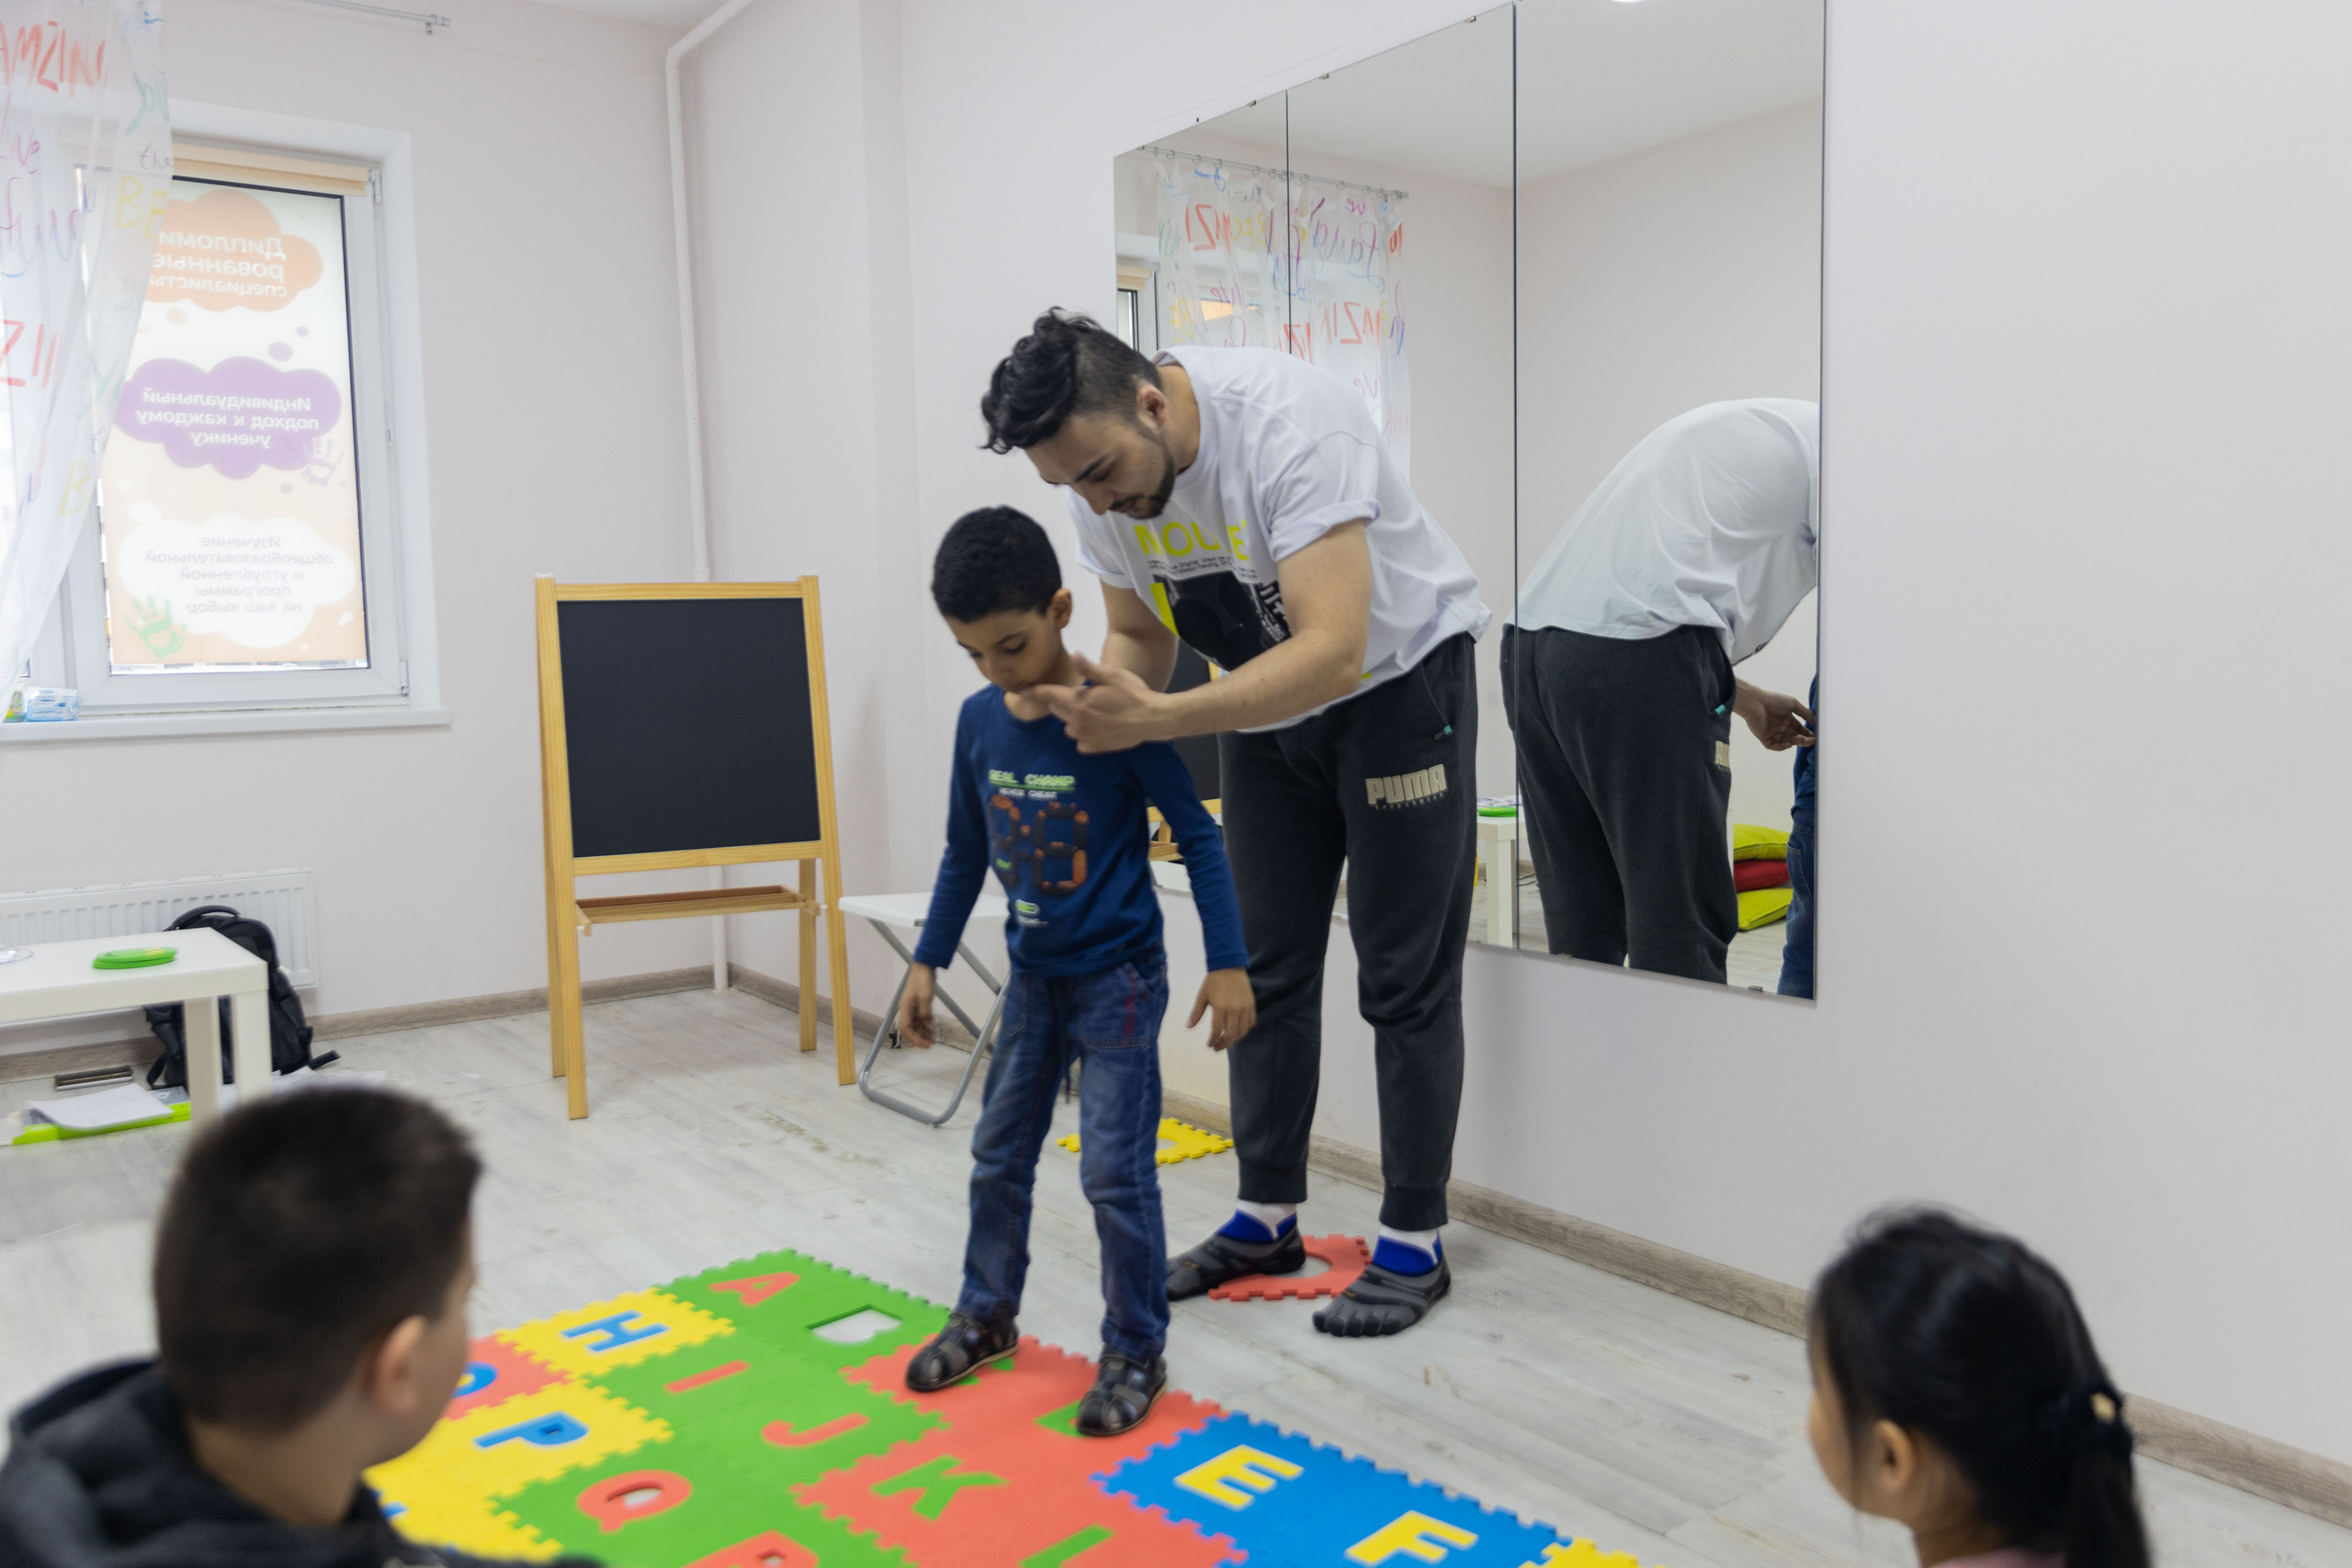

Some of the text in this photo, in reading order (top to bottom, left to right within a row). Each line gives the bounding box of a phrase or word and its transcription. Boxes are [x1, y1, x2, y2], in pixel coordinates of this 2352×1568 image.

[1364, 763, 1448, 805] PUMA
[708, 1270, 801, 1307] A
[560, 1309, 673, 1354] H
[662, 1359, 752, 1394] I
[471, 1409, 590, 1450] P
[760, 1411, 872, 1448] J
[867, 1453, 1012, 1521] K
[1174, 1444, 1306, 1511] E
[574, 1468, 694, 1534] Q
[1344, 1509, 1479, 1566] F
